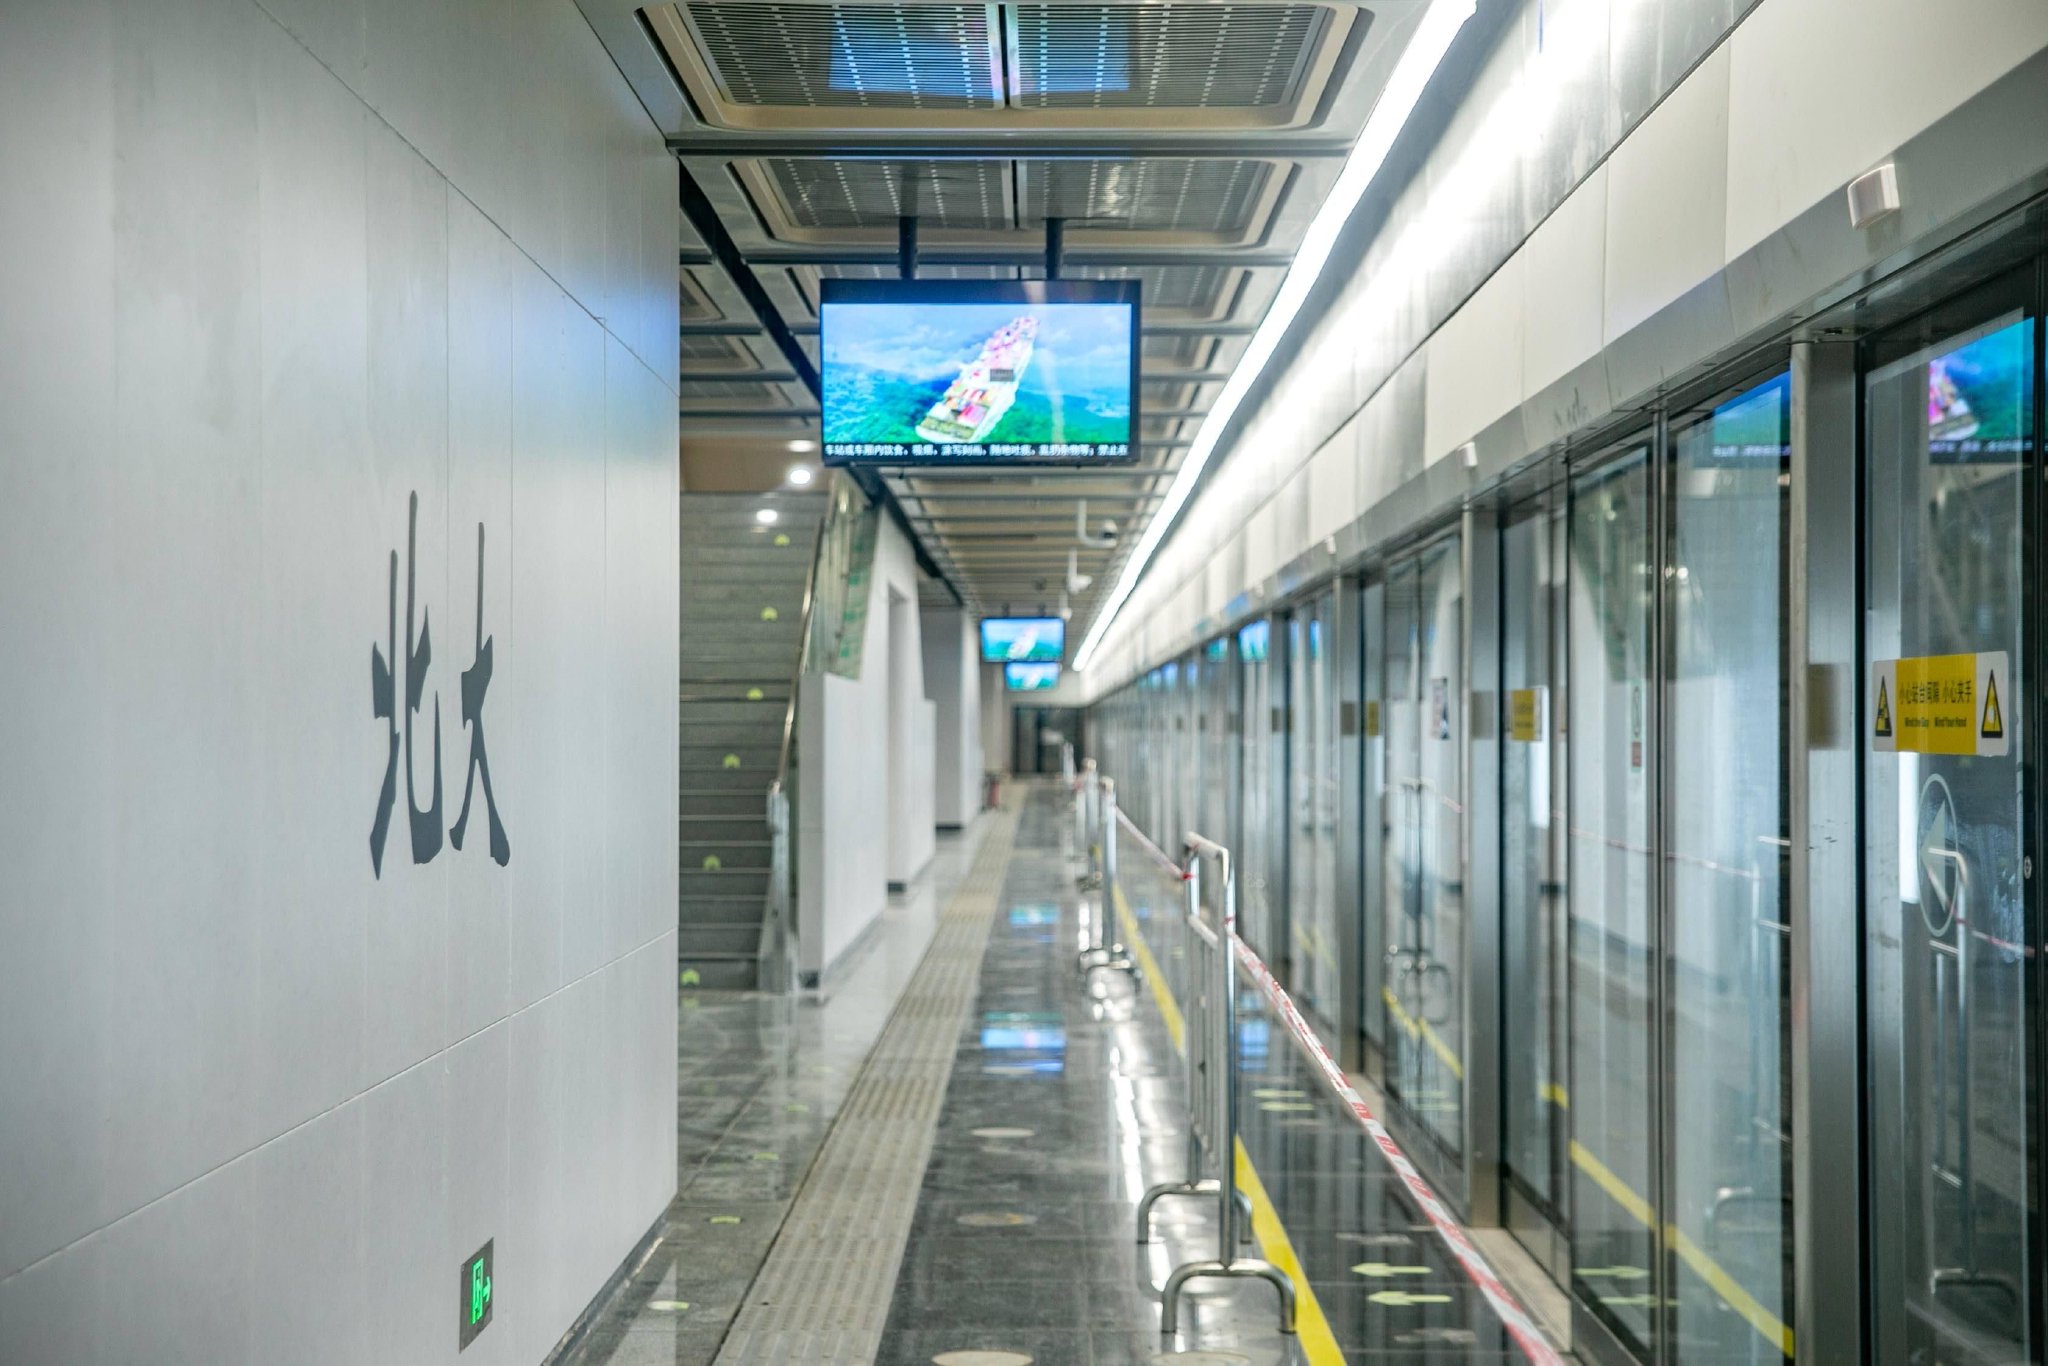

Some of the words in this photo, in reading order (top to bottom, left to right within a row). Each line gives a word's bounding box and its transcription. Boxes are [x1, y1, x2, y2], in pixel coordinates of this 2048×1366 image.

[1899, 681, 1939, 704] 小心站台间隙
[1943, 679, 1972, 703] 小心夹手
